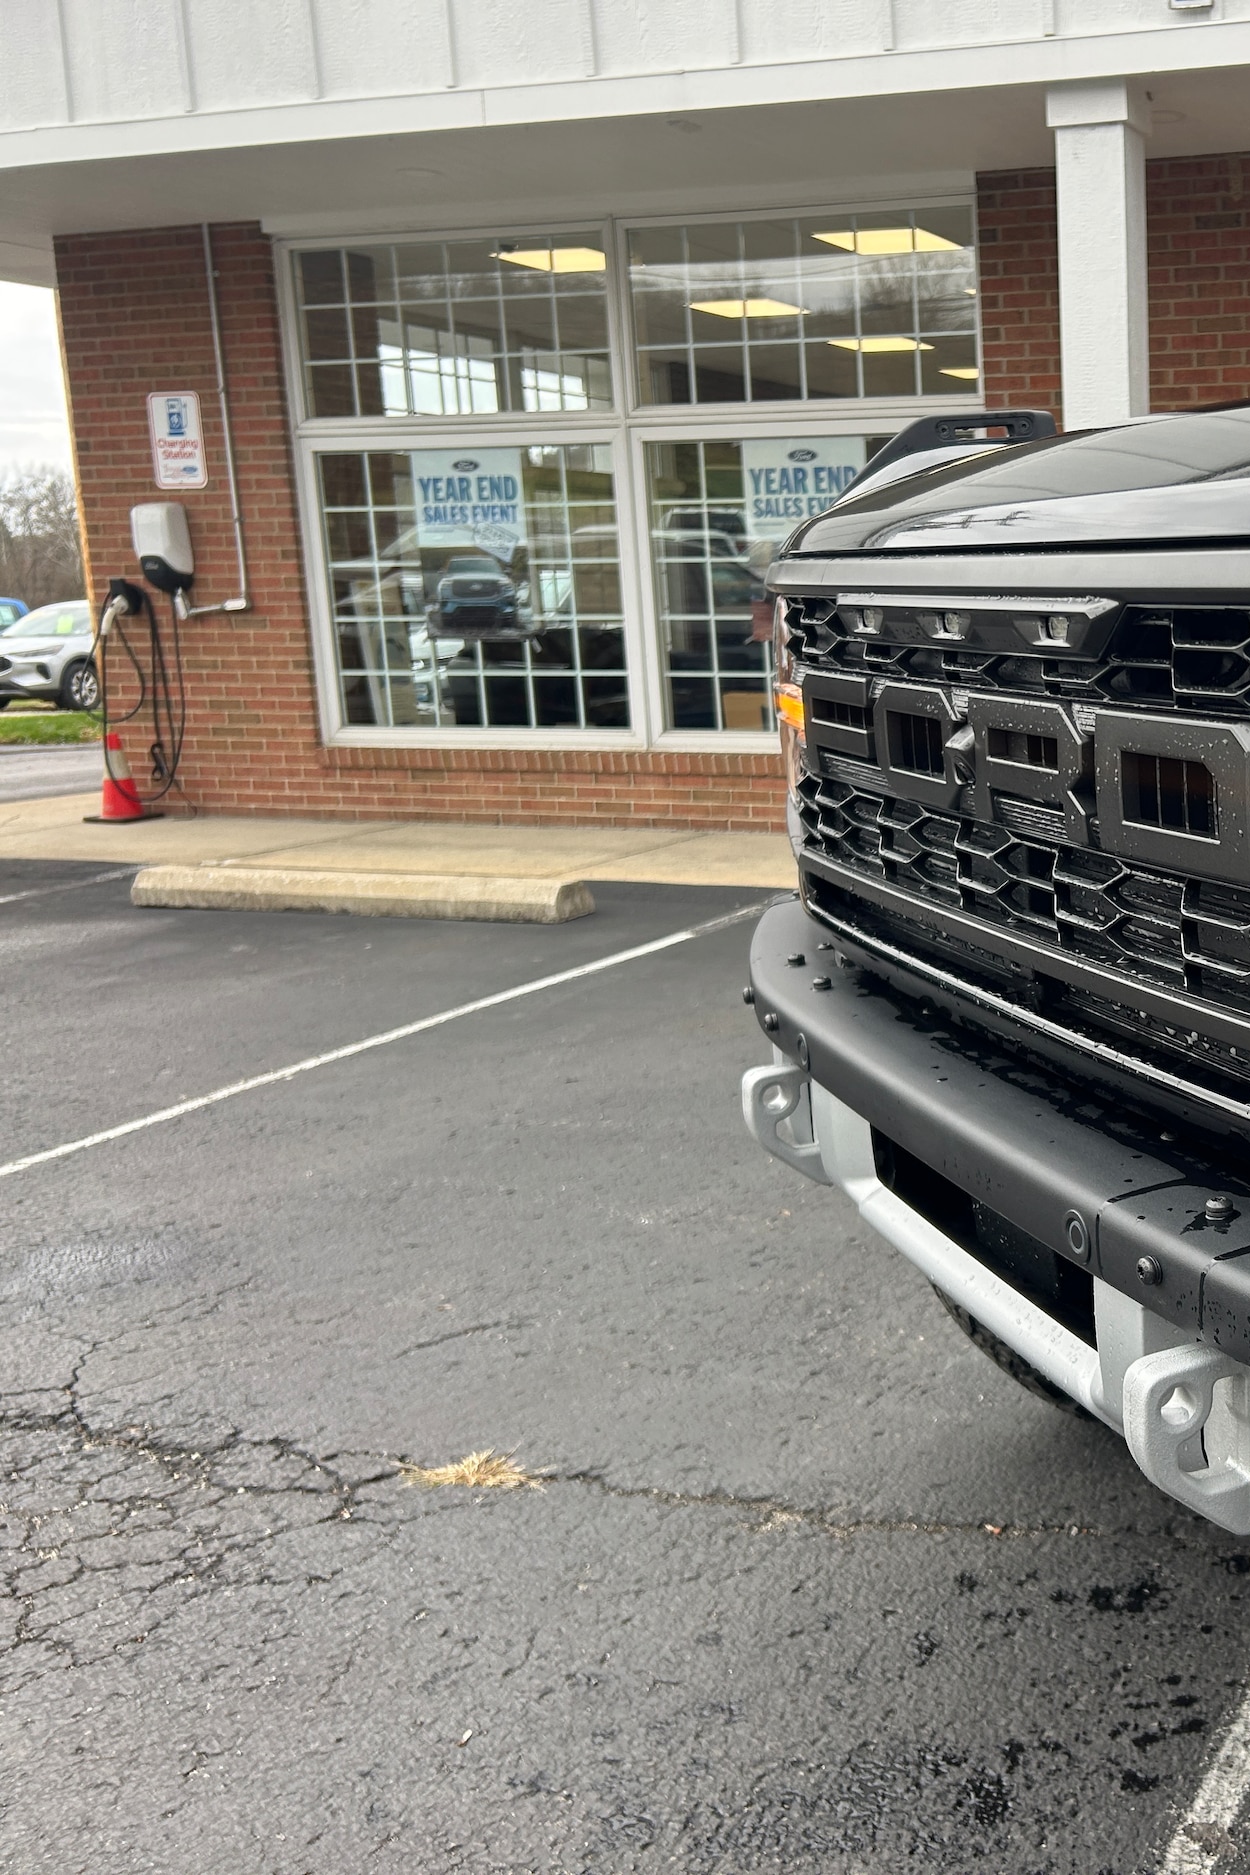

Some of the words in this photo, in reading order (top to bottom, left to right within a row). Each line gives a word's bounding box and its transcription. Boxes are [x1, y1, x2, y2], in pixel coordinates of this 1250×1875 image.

[157, 438, 198, 450] Charging
[162, 449, 196, 460] Station
[418, 476, 473, 503] YEAR
[476, 475, 519, 502] END
[749, 466, 809, 496] YEAR
[423, 505, 469, 525] SALES
[471, 504, 519, 525] EVENT
[753, 498, 804, 518] SALES
